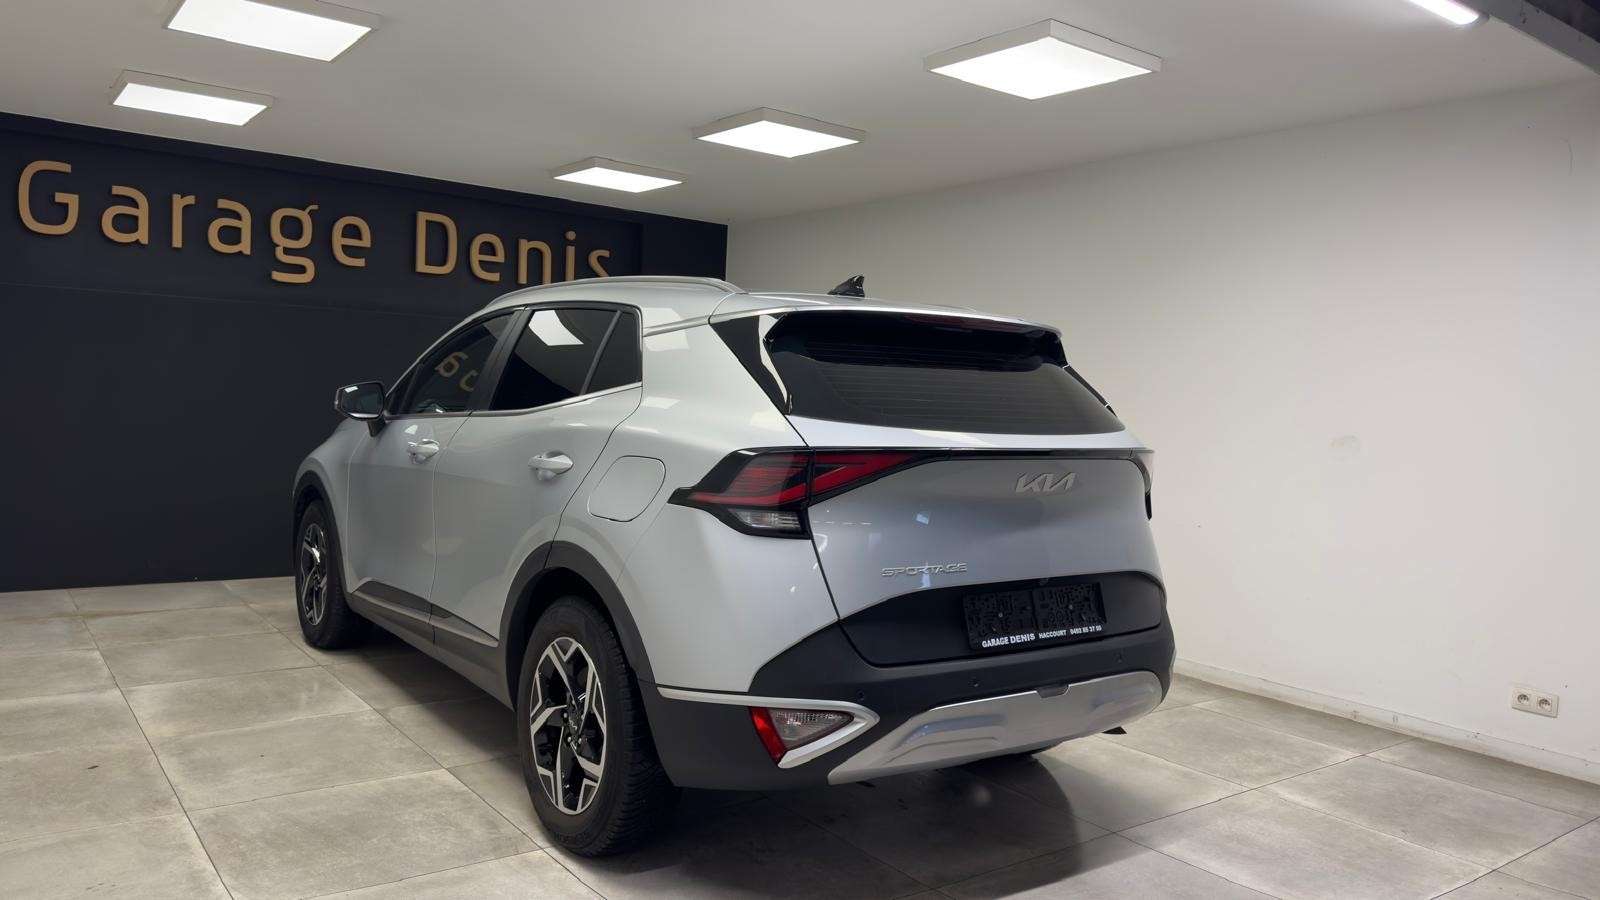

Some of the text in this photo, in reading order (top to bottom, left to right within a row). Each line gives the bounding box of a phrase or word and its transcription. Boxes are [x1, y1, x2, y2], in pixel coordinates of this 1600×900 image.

[18, 160, 610, 285] Garage Denis
[881, 562, 967, 577] SPORTAGE
[982, 637, 1009, 648] GARAGE
[1010, 634, 1035, 643] DENIS
[1039, 630, 1066, 638] HACCOURT
